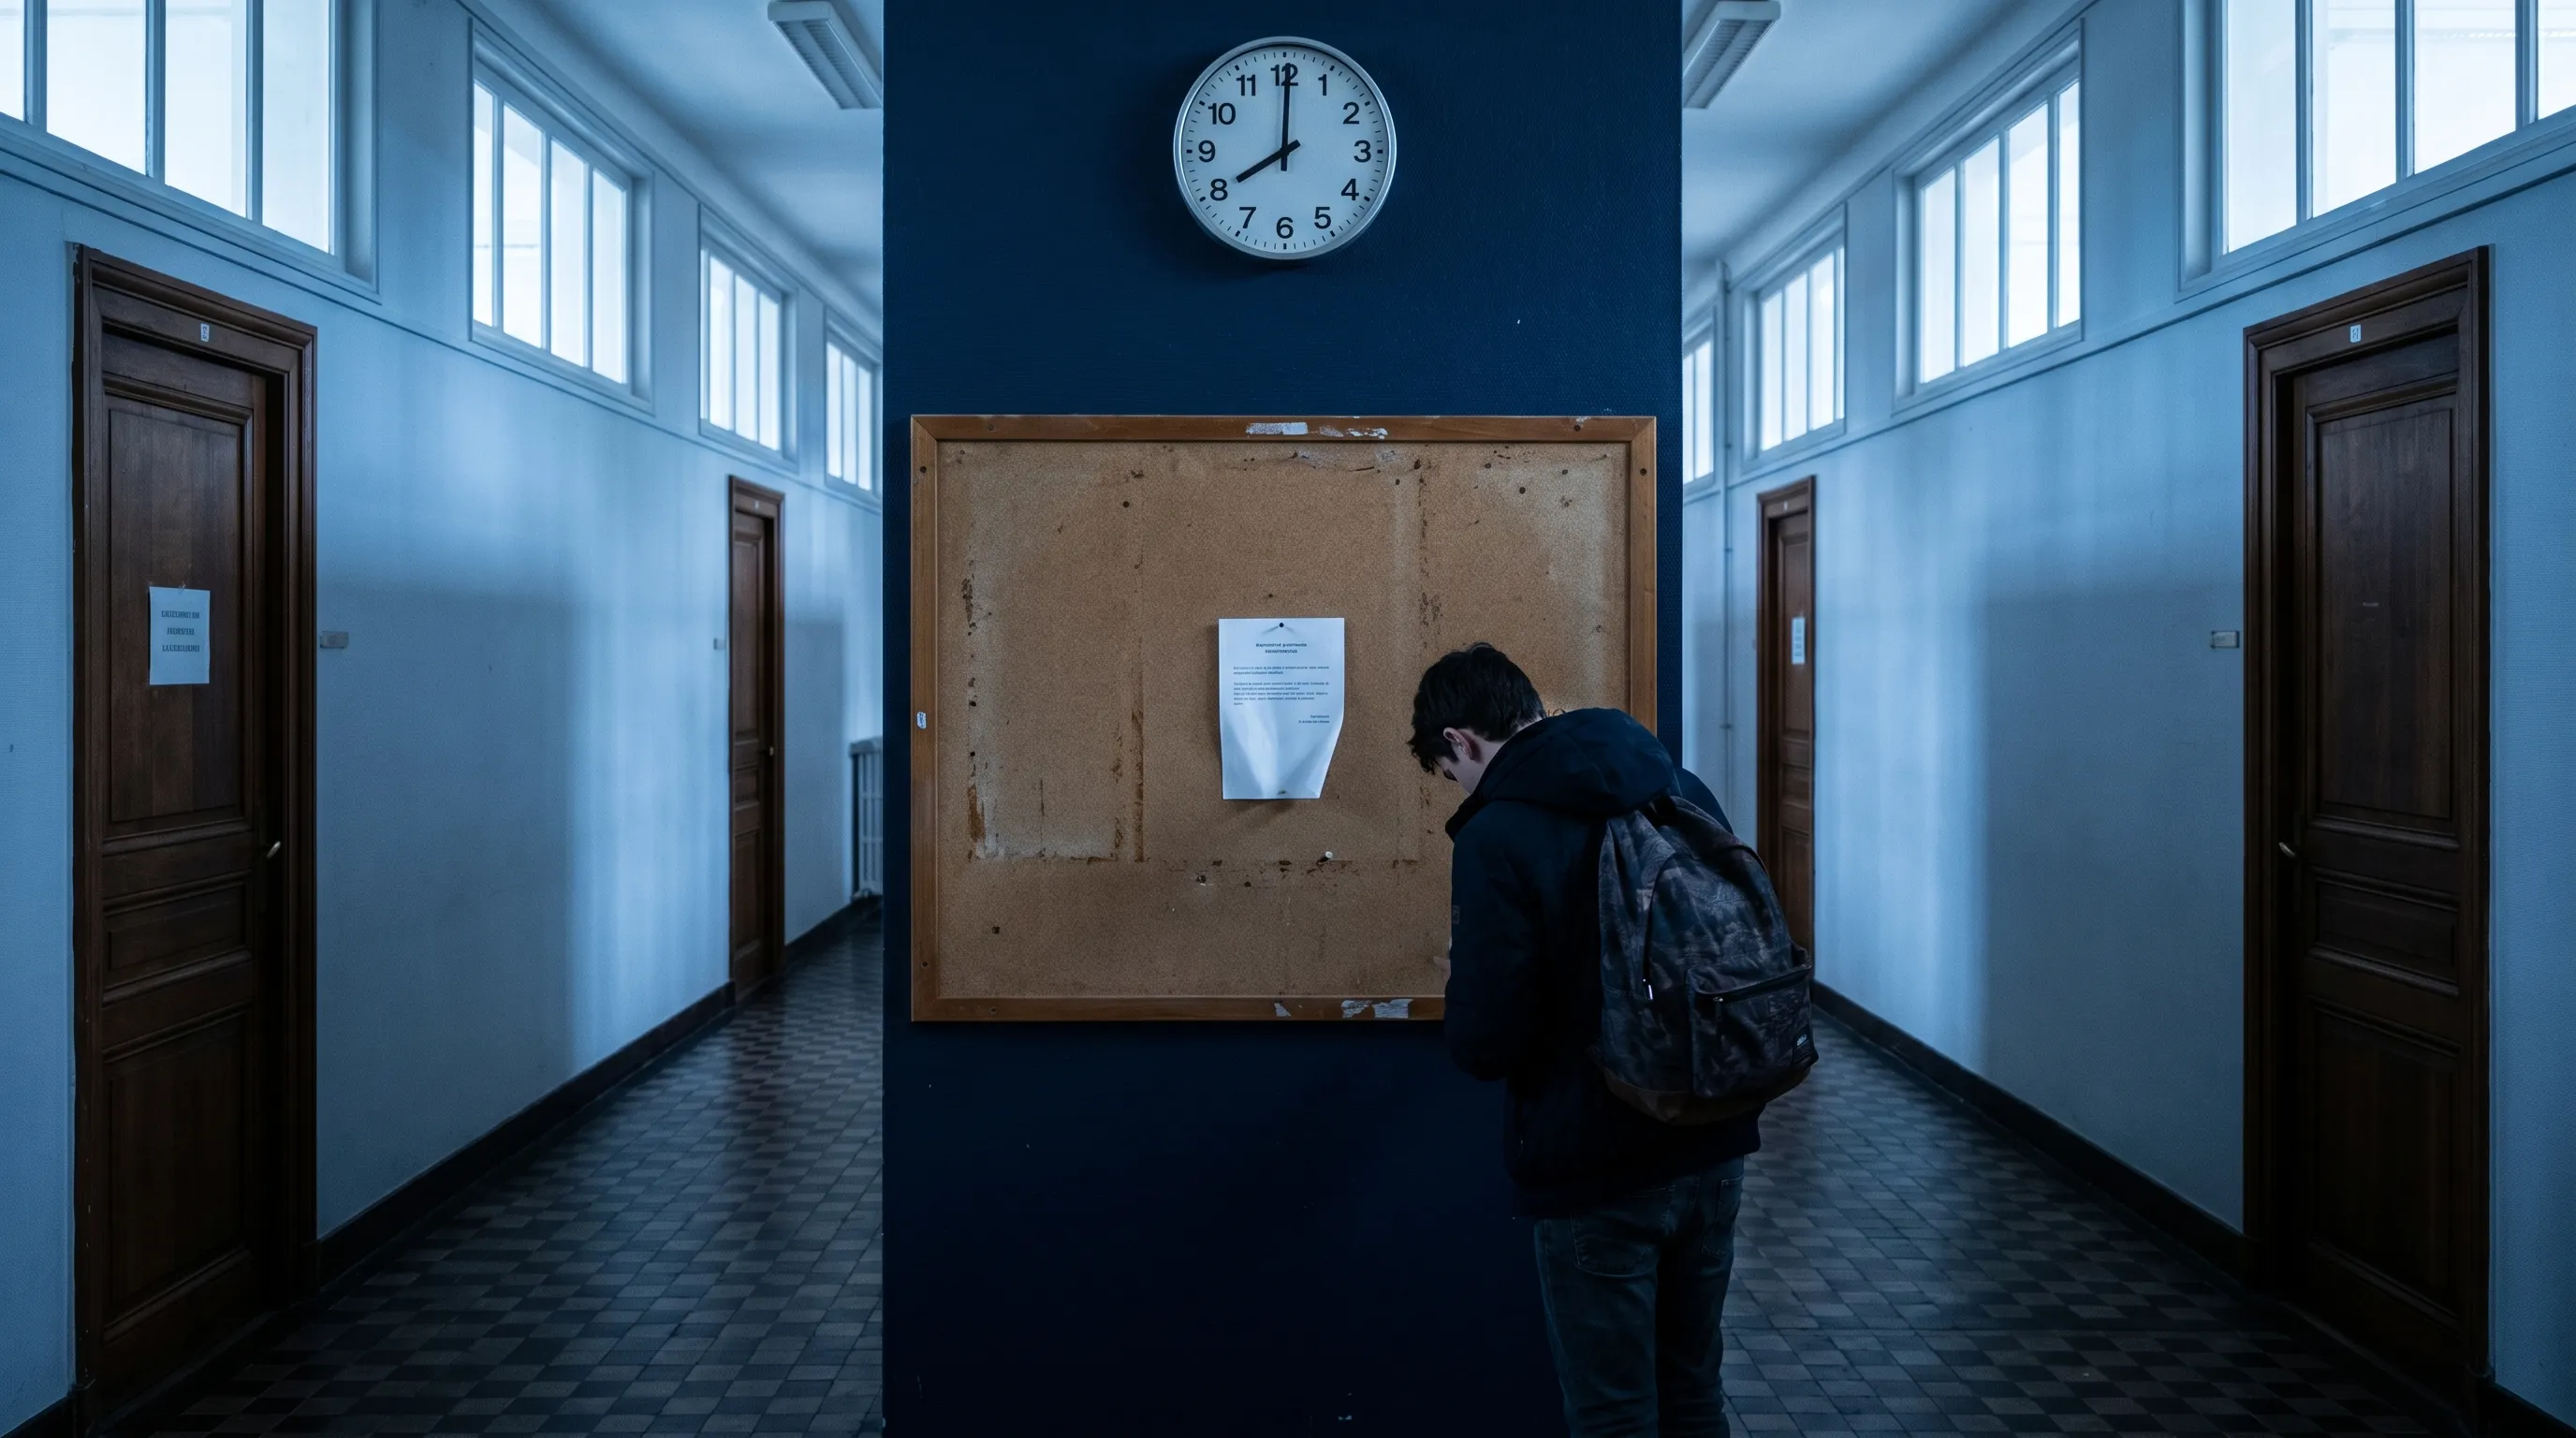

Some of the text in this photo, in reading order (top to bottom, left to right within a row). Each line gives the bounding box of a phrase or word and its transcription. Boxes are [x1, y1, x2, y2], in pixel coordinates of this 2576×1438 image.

[1237, 75, 1255, 95] 11
[1270, 63, 1298, 86] 12
[1318, 74, 1326, 95] 1
[1208, 103, 1236, 125] 10
[1342, 102, 1359, 124] 2
[1198, 140, 1215, 162] 9
[1354, 140, 1371, 162] 3
[1210, 179, 1228, 200] 8
[1341, 179, 1359, 200] 4
[1239, 207, 1256, 228] 7
[1277, 217, 1294, 239] 6
[1314, 207, 1331, 228] 5
